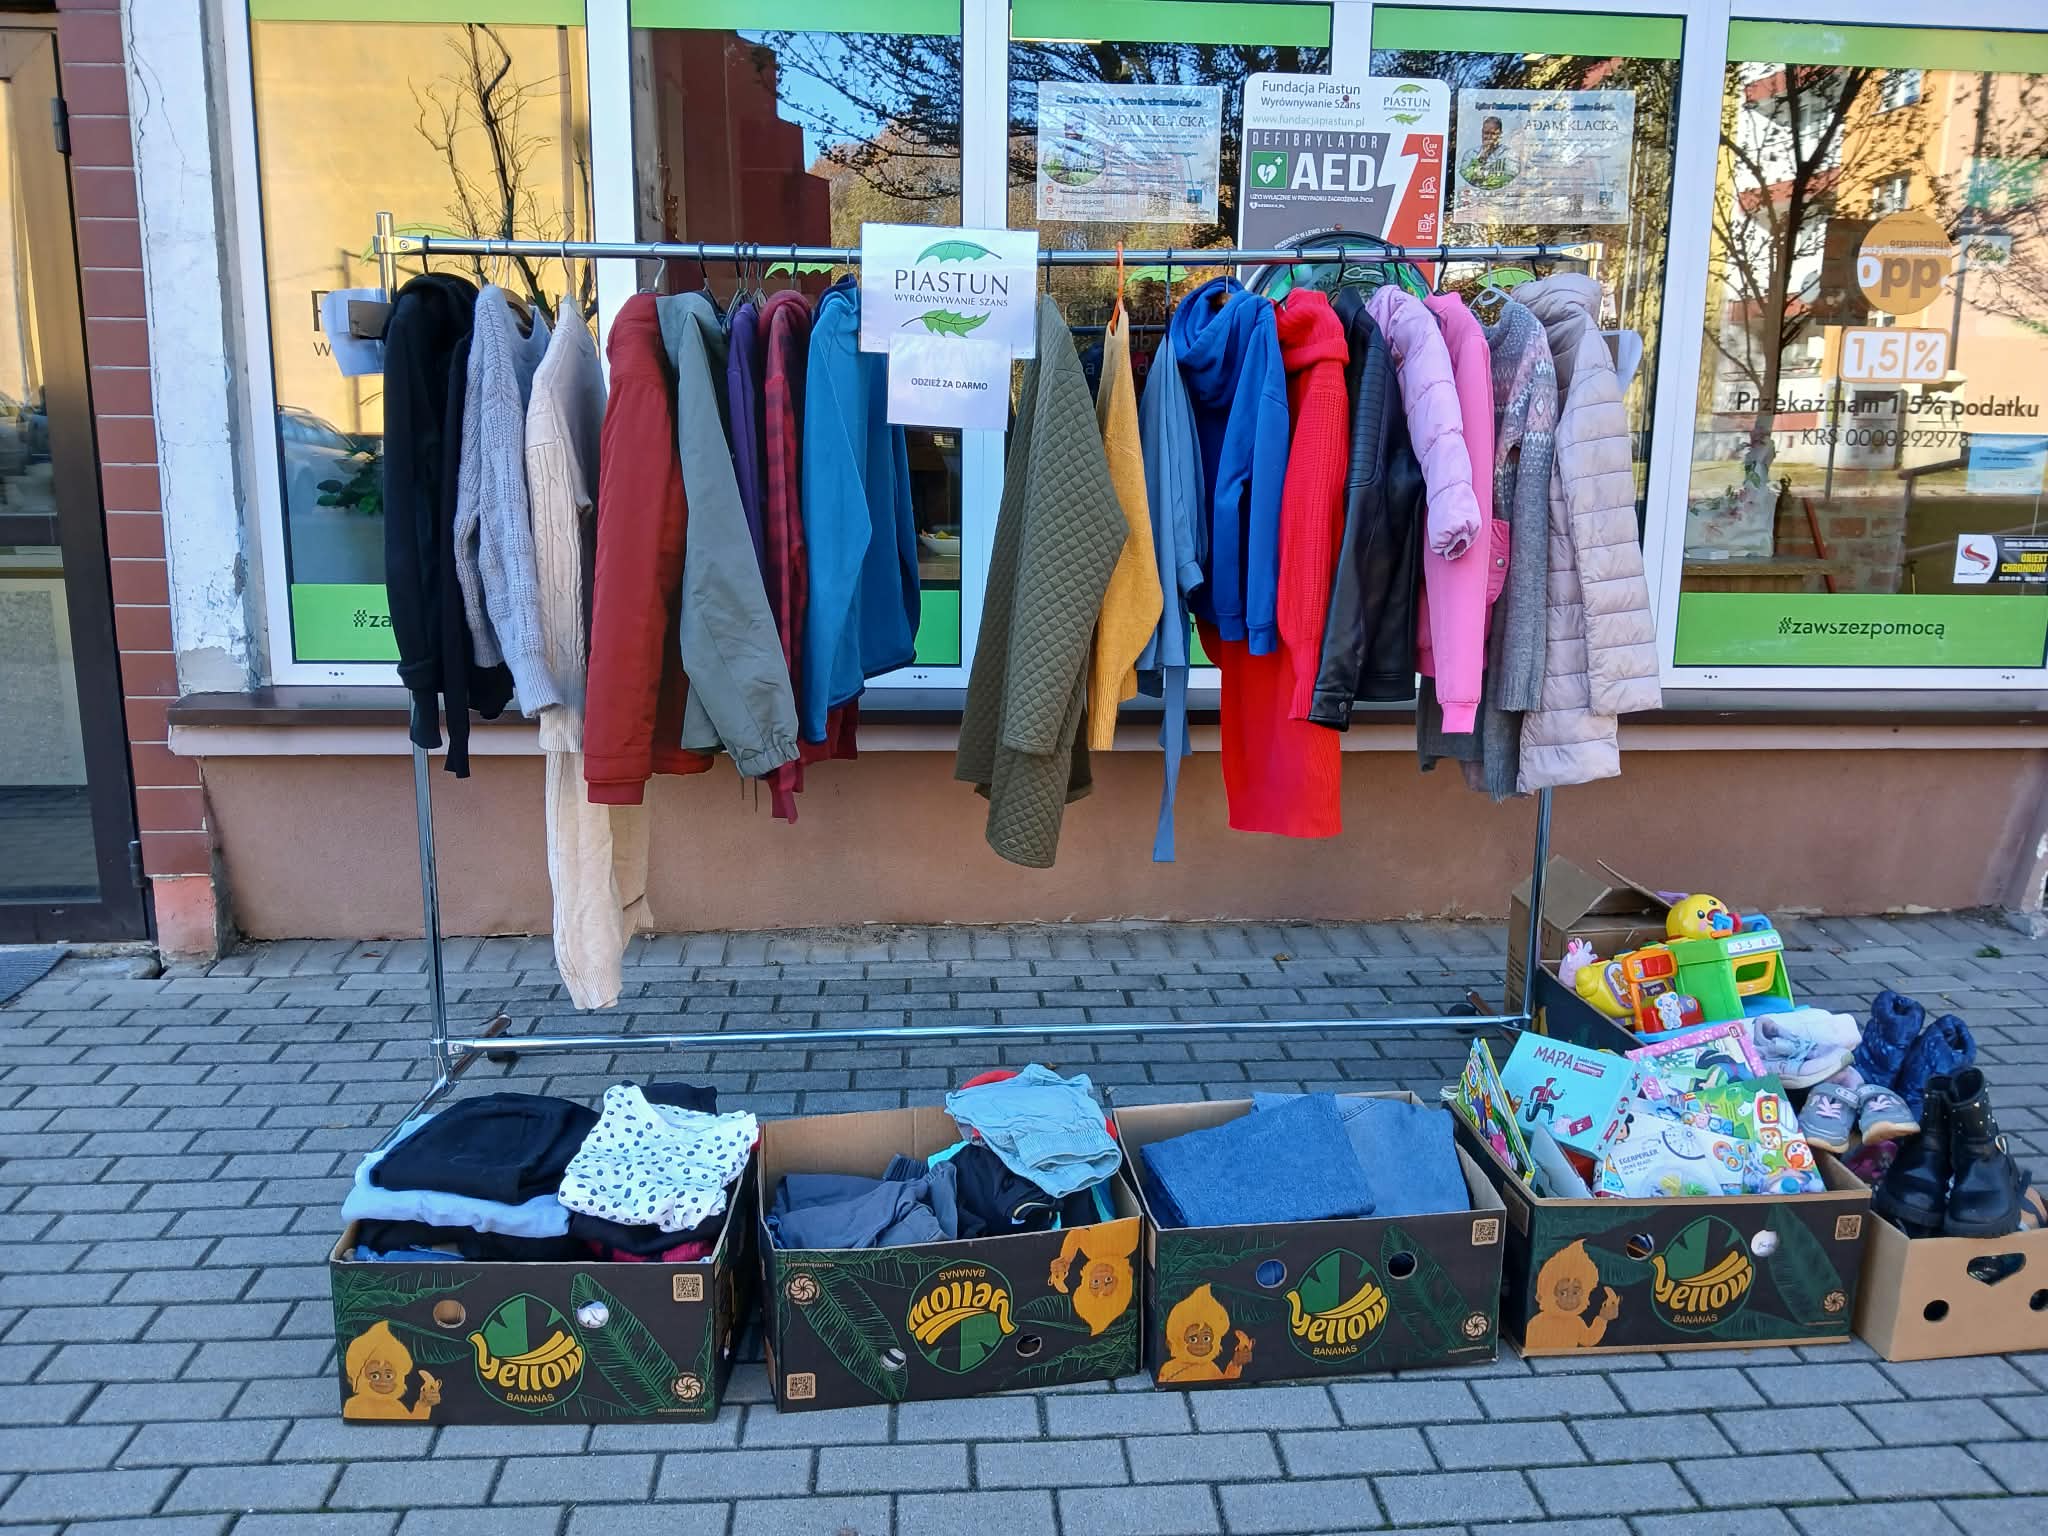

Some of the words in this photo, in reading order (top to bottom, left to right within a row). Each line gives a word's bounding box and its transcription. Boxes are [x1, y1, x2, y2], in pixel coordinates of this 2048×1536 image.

[1262, 80, 1315, 95] Fundacja
[1318, 82, 1361, 95] Piastun
[1261, 96, 1332, 110] Wyrównywanie
[1334, 98, 1361, 109] Szans
[1383, 96, 1431, 108] PIASTUN
[1253, 113, 1365, 127] www.fundacjapiastun.pl
[1252, 131, 1378, 149] DEFIBRYLATOR
[1290, 152, 1376, 192] AED
[895, 270, 1009, 296] PIASTUN
[894, 293, 975, 306] WYRÓWNYWANIE
[979, 298, 1009, 307] SZANS
[911, 377, 941, 388] ODZIEŻ
[942, 379, 953, 388] ZA
[955, 381, 988, 391] DARMO
[1736, 390, 1825, 412] Przekaż
[1828, 398, 1879, 414] nam
[1951, 395, 2040, 420] podatku
[1801, 428, 1838, 447] KRS
[1846, 429, 1969, 449] 0000292978
[1778, 617, 1945, 640] #zawszezpomocą
[1533, 1046, 1574, 1069] MAPA
[939, 1268, 986, 1281] BANANAS
[1652, 1254, 1753, 1312] yellow
[908, 1281, 1016, 1334] yellow
[1285, 1290, 1388, 1345] yellow
[1673, 1313, 1718, 1324] BANANAS
[1313, 1344, 1358, 1356] BANANAS
[469, 1331, 584, 1390] yellow
[506, 1391, 555, 1404] BANANAS
